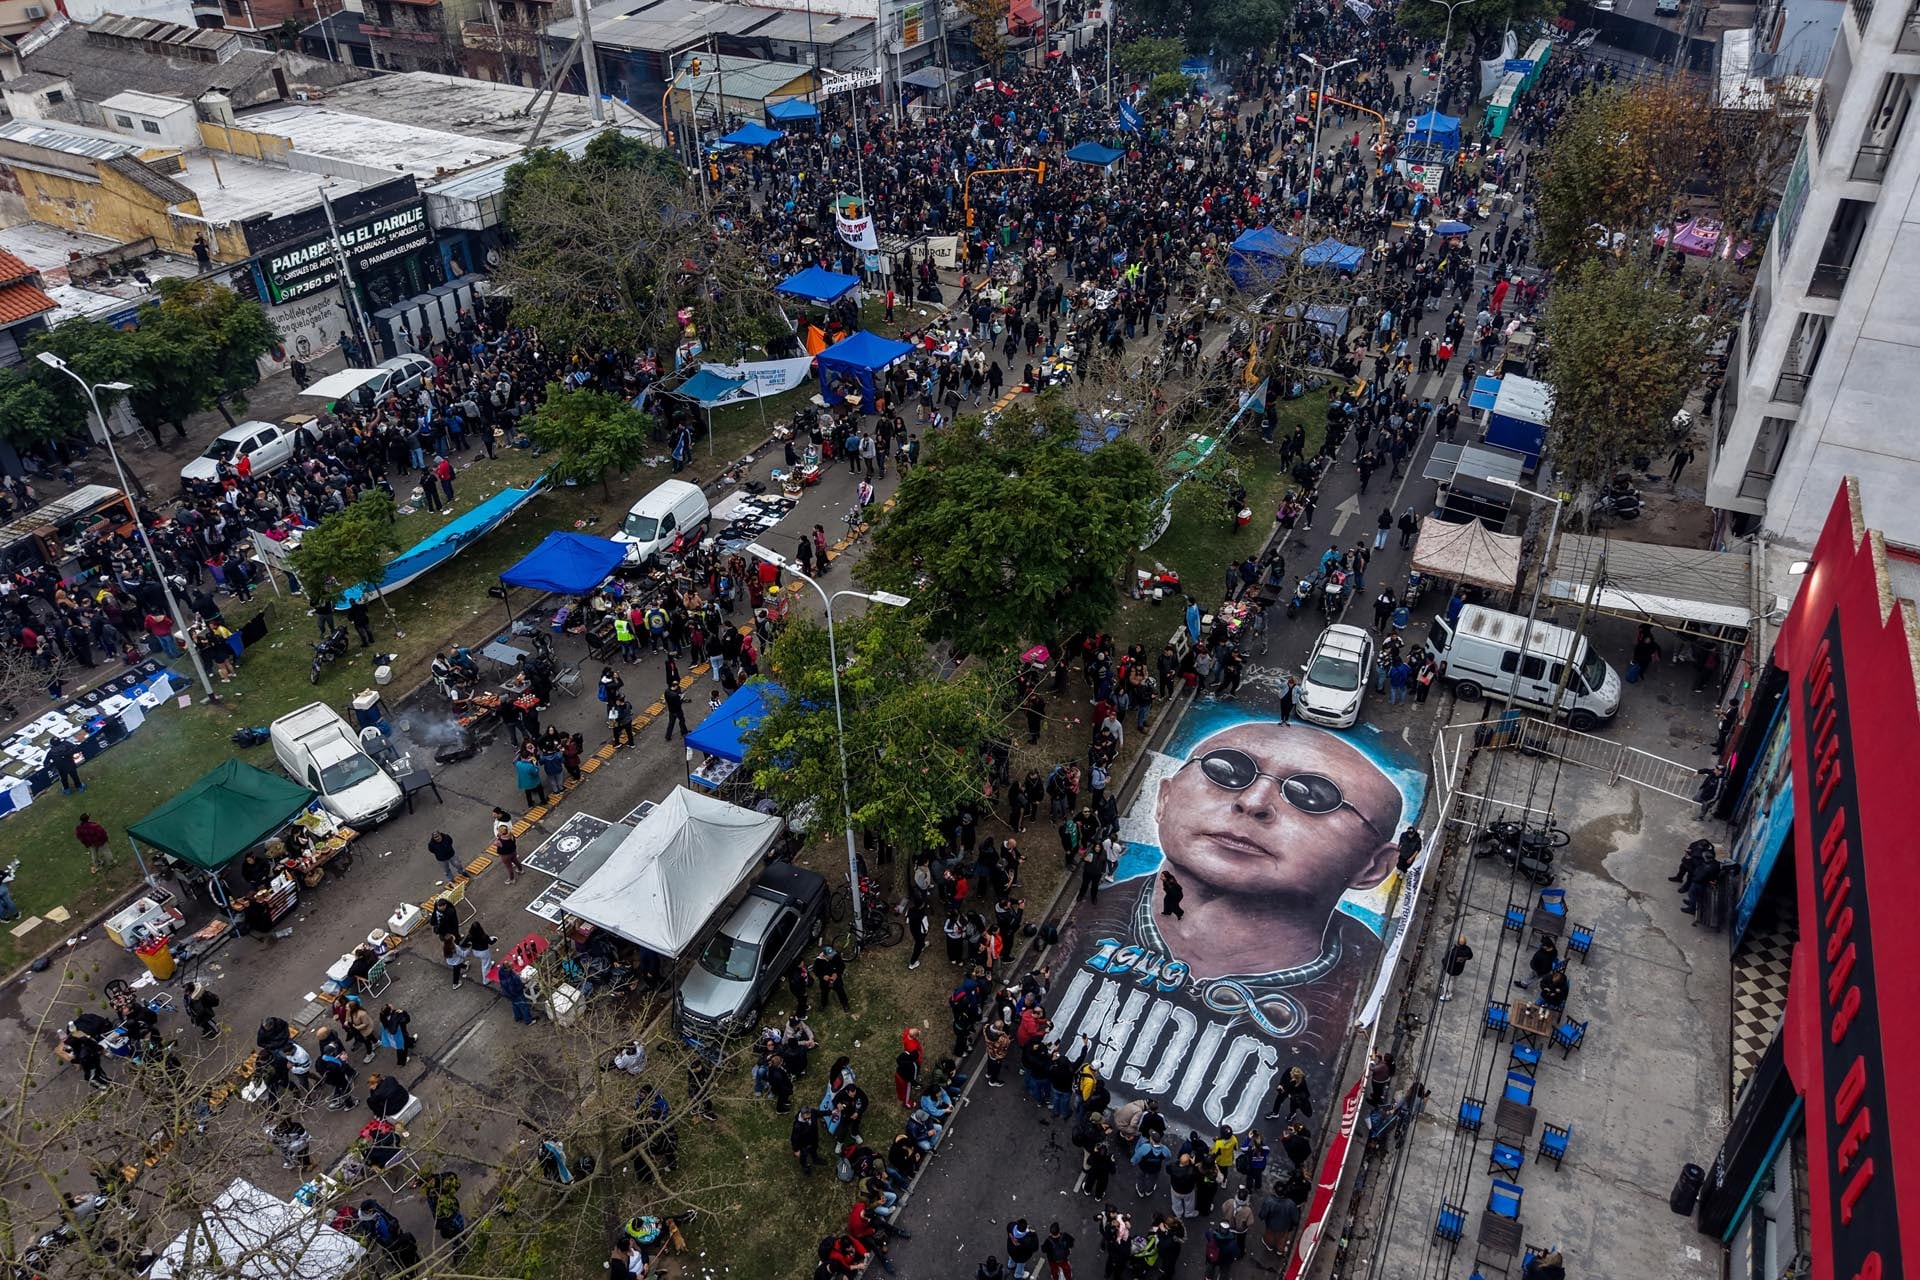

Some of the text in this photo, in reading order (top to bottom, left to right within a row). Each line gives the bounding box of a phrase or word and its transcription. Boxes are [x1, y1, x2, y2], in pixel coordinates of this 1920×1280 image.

[356, 226, 373, 243] EL
[374, 207, 423, 236] PARQUE
[1085, 937, 1191, 993] 1949
[1808, 639, 1841, 813] OUTLET
[1834, 1055, 1874, 1226] DEL
[1043, 968, 1279, 1134] INDIO
